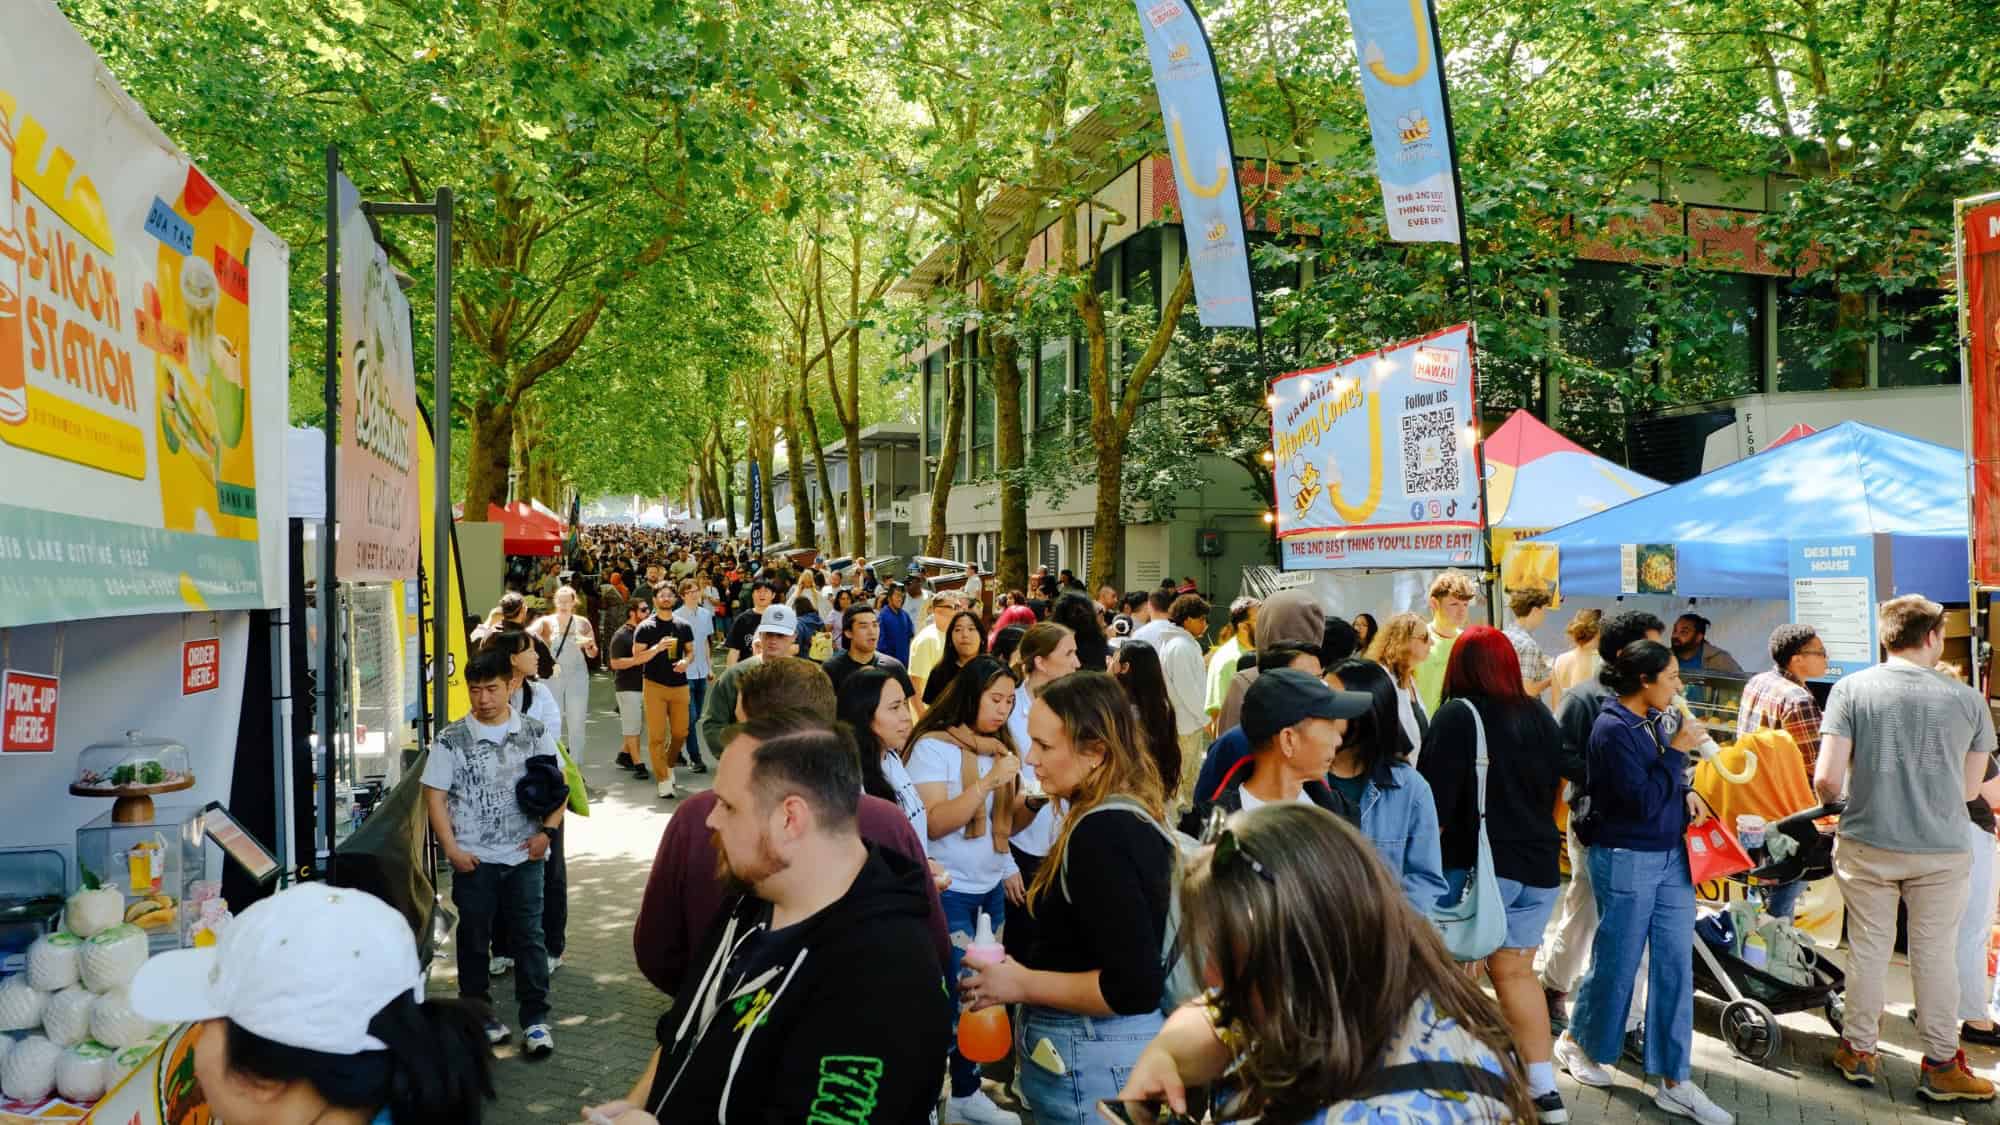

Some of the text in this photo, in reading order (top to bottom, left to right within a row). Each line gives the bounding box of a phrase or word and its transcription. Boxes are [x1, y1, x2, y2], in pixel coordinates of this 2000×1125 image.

[1398, 205, 1425, 215] THING
[1408, 217, 1429, 227] EVER
[25, 205, 121, 334] SAIGON
[26, 296, 137, 415] STATION
[1405, 392, 1434, 410] Follow
[1274, 416, 1321, 468] Honey
[1291, 533, 1472, 556] THE 2ND BEST THING YOU'LL EVER EAT!
[1811, 559, 1849, 571] HOUSE
[188, 645, 215, 666] ORDER
[191, 667, 213, 688] HERE
[6, 682, 57, 713] PICK-UP
[15, 716, 45, 744] HERE
